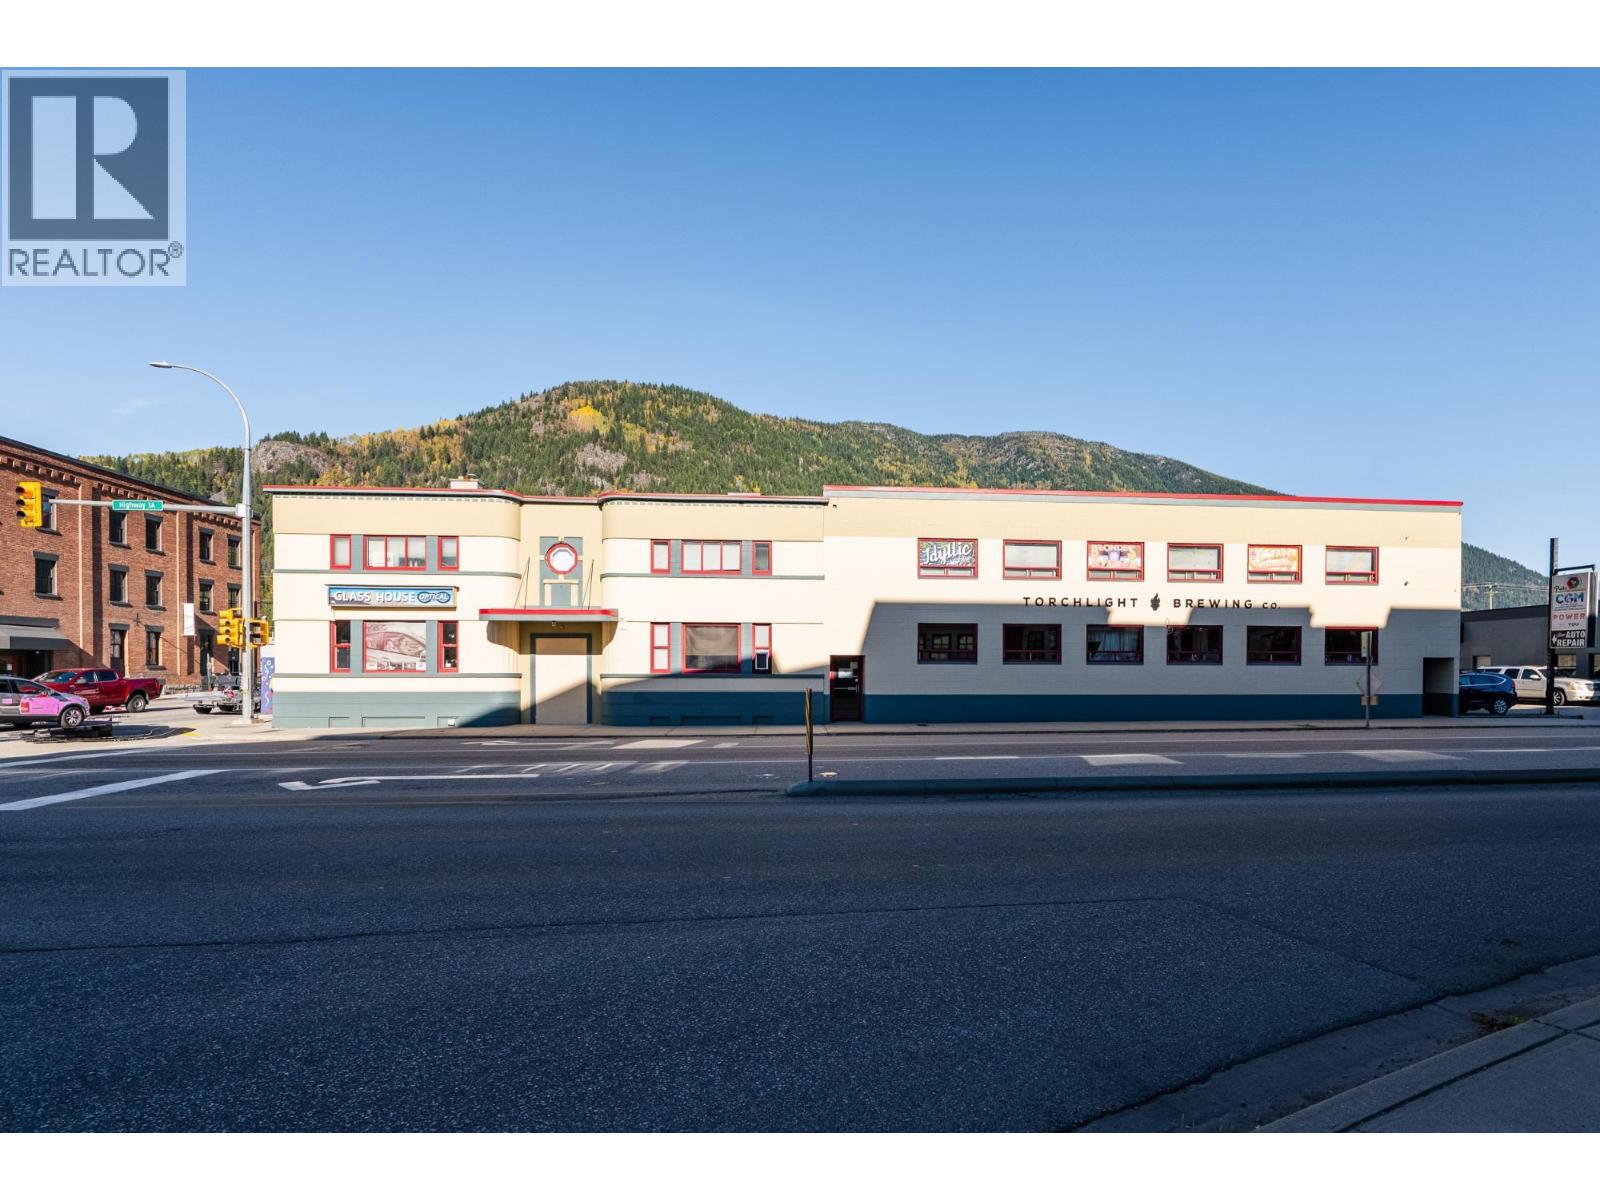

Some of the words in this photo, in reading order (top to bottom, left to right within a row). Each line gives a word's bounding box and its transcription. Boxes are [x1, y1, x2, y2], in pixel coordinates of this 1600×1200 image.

[921, 541, 973, 565] Idyllic
[333, 591, 372, 602] GLASS
[376, 592, 416, 603] HOUSE
[1023, 597, 1138, 608] TORCHLIGHT
[1173, 599, 1253, 609] BREWING
[1556, 592, 1584, 604] CGM
[1556, 638, 1585, 647] REPAIR
